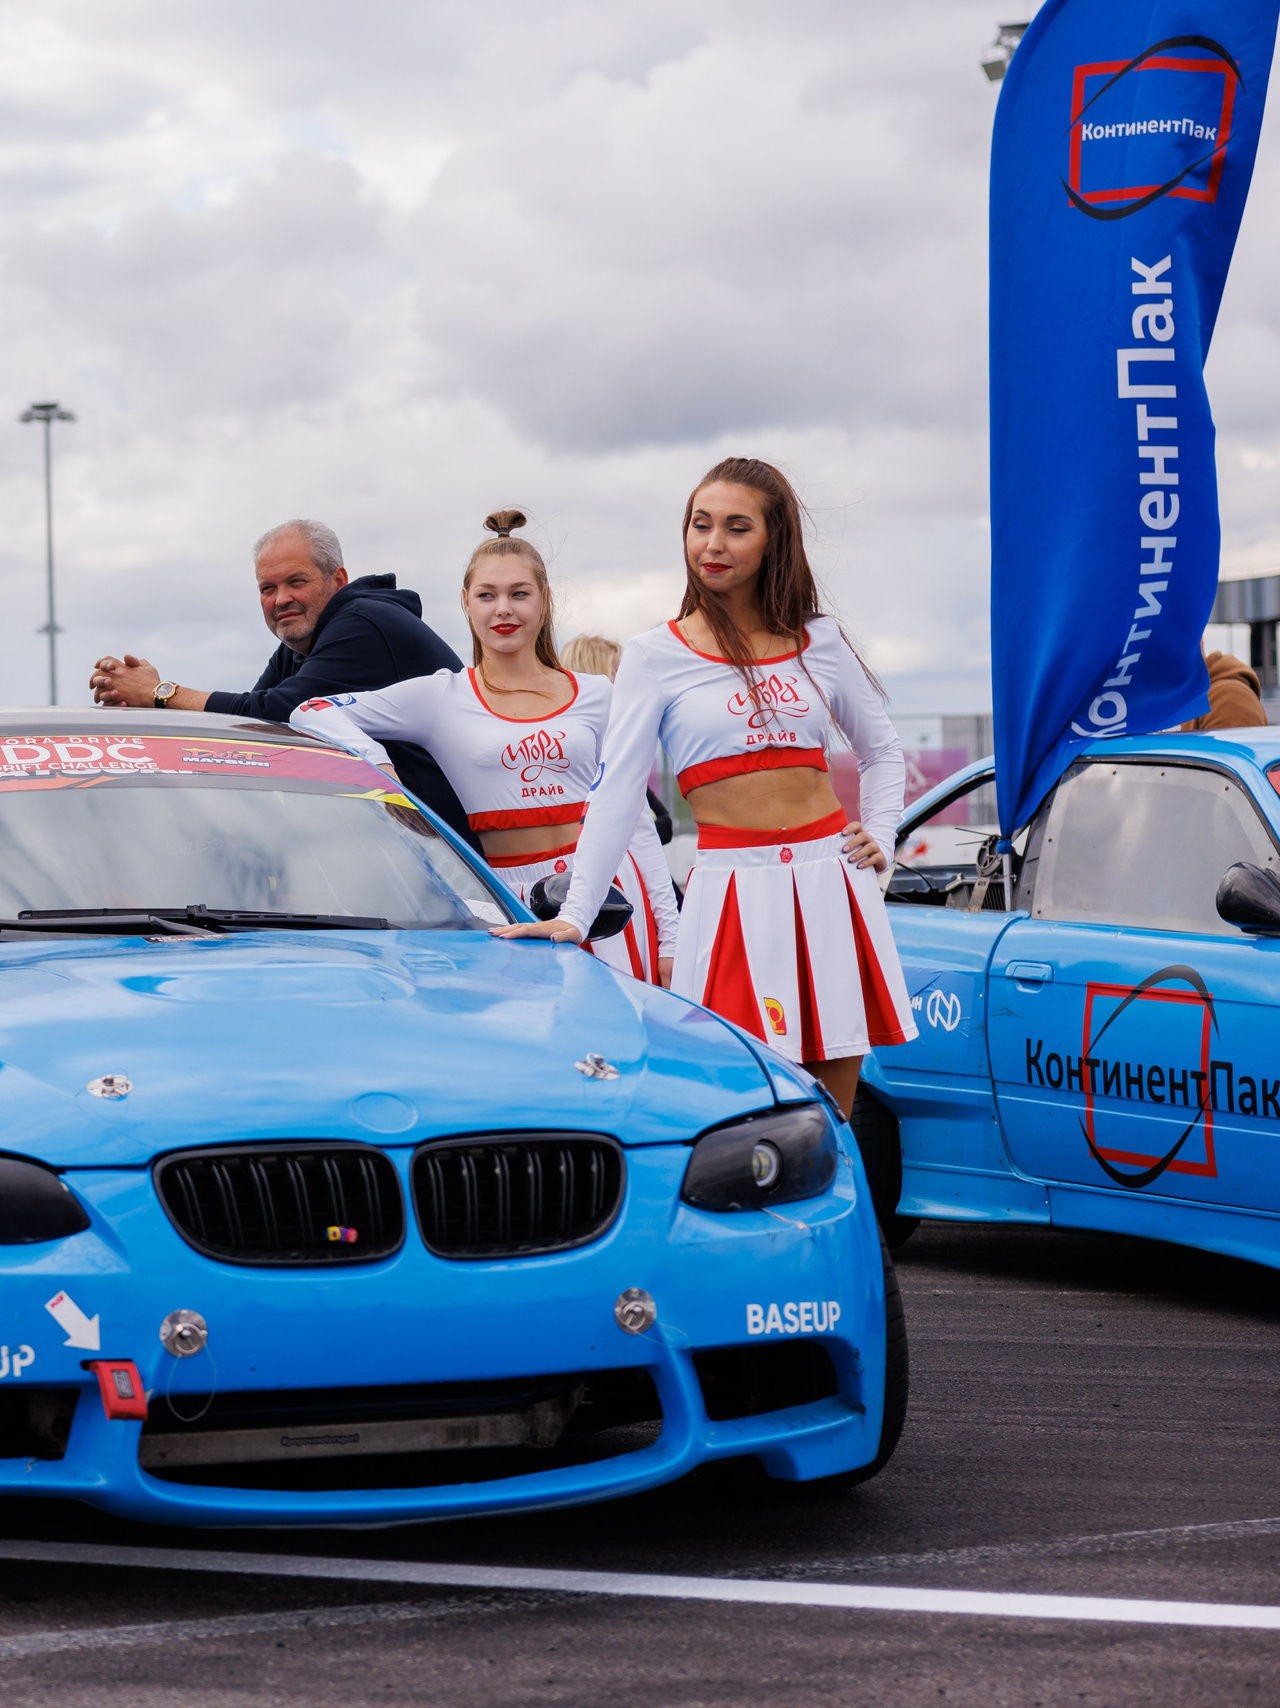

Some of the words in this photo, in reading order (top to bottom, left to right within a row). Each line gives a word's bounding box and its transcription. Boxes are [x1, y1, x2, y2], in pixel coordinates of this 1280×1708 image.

[1081, 118, 1217, 141] КонтинентПак
[68, 737, 144, 745] DRIVE
[746, 730, 796, 745] ДРАЙВ
[48, 762, 159, 770] CHALLENGE
[182, 757, 270, 767] MATSURI
[522, 783, 564, 798] ДРАЙВ
[1025, 1038, 1280, 1119] КонтинентПак
[746, 1301, 841, 1335] BASEUP
